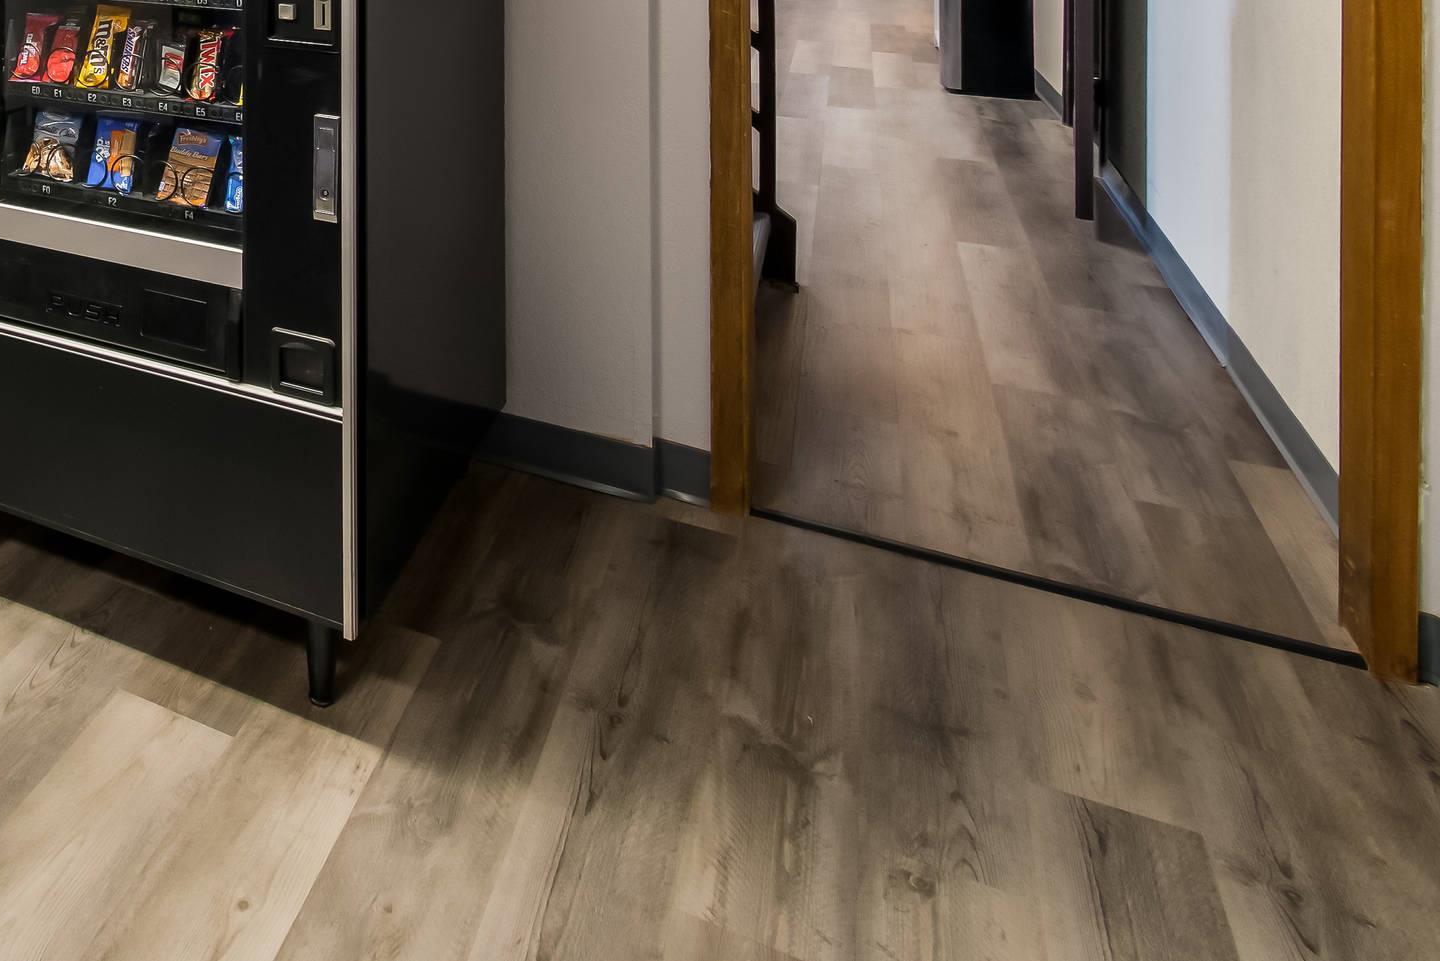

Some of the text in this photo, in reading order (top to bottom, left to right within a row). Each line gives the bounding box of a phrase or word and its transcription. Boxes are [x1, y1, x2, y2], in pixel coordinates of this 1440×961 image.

[121, 26, 137, 74] SNICKERS
[31, 86, 41, 95] E0
[54, 88, 62, 97] E1
[87, 93, 97, 102] E2
[122, 97, 132, 107] E3
[158, 102, 168, 111] E4
[195, 107, 206, 117] E5
[169, 146, 209, 161] Buddy Bars
[42, 185, 194, 220] F0 F2 F4
[46, 294, 123, 328] PUSH
